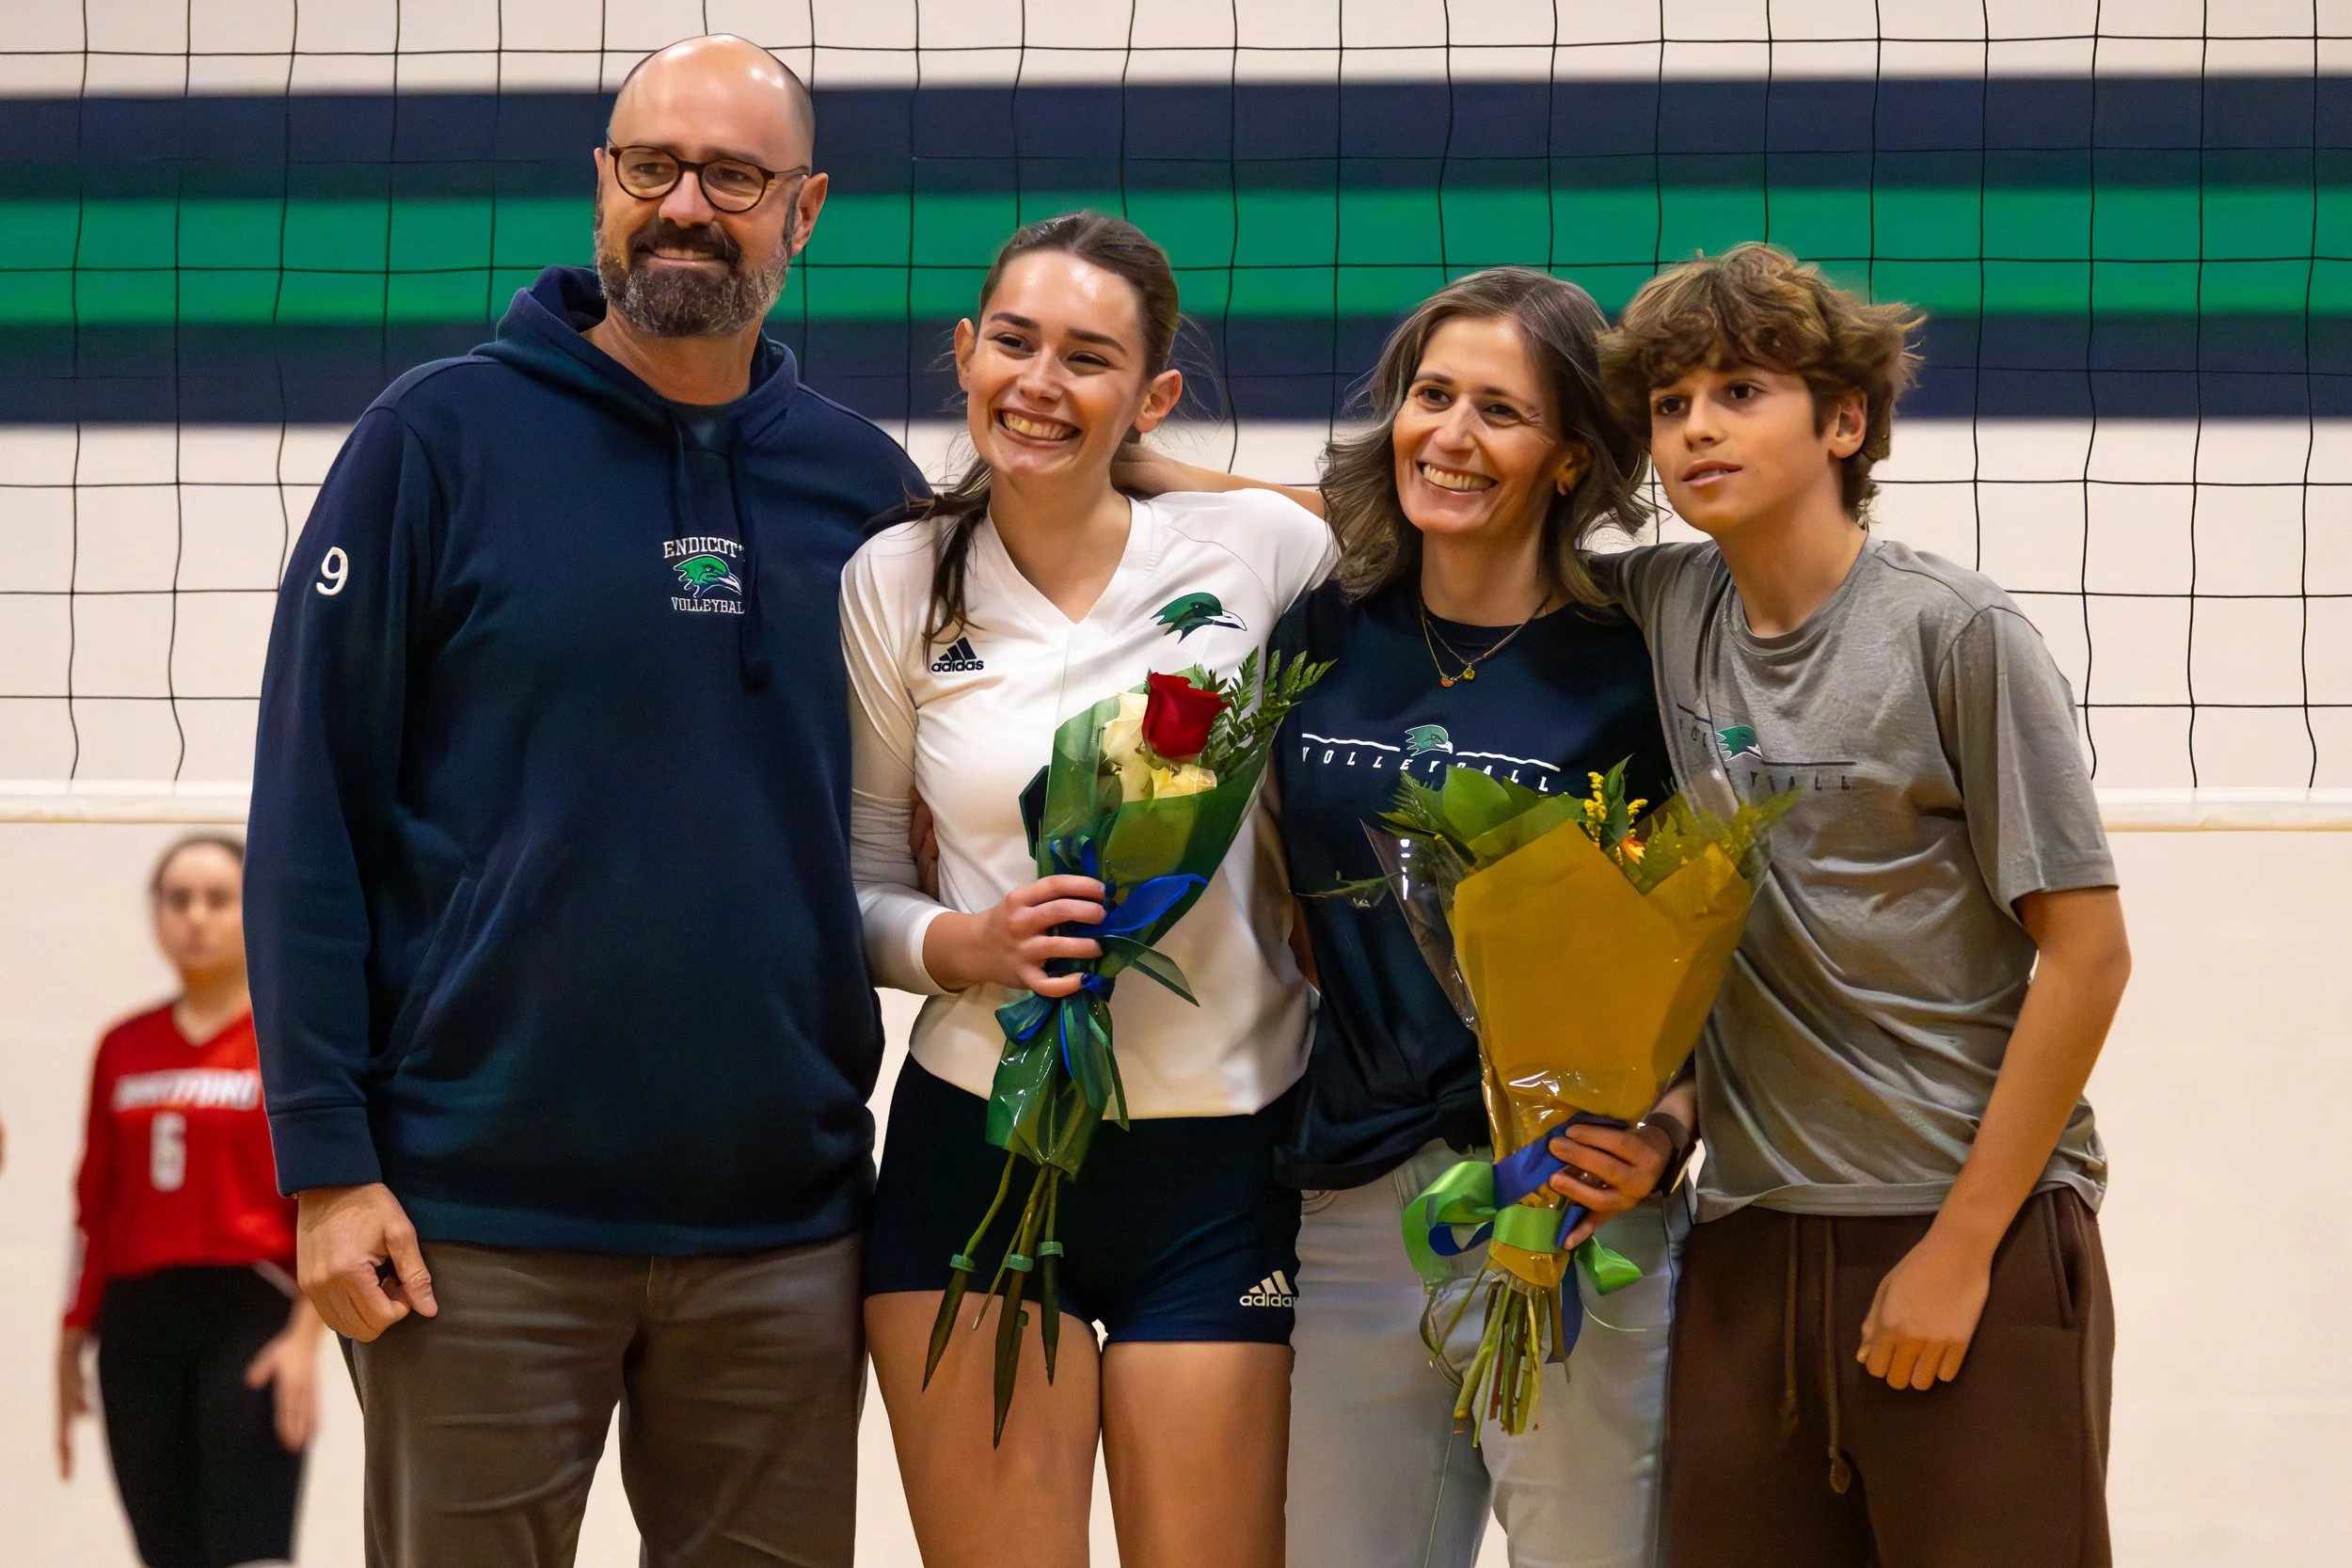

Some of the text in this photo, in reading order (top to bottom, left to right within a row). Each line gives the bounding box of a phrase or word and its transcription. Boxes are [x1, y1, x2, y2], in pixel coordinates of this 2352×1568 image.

[663, 537, 745, 562] ENDICOT
[316, 546, 348, 595] 9
[671, 596, 745, 614] VOLLEYBAL
[931, 659, 984, 673] adidas
[1239, 1292, 1293, 1307] adida
